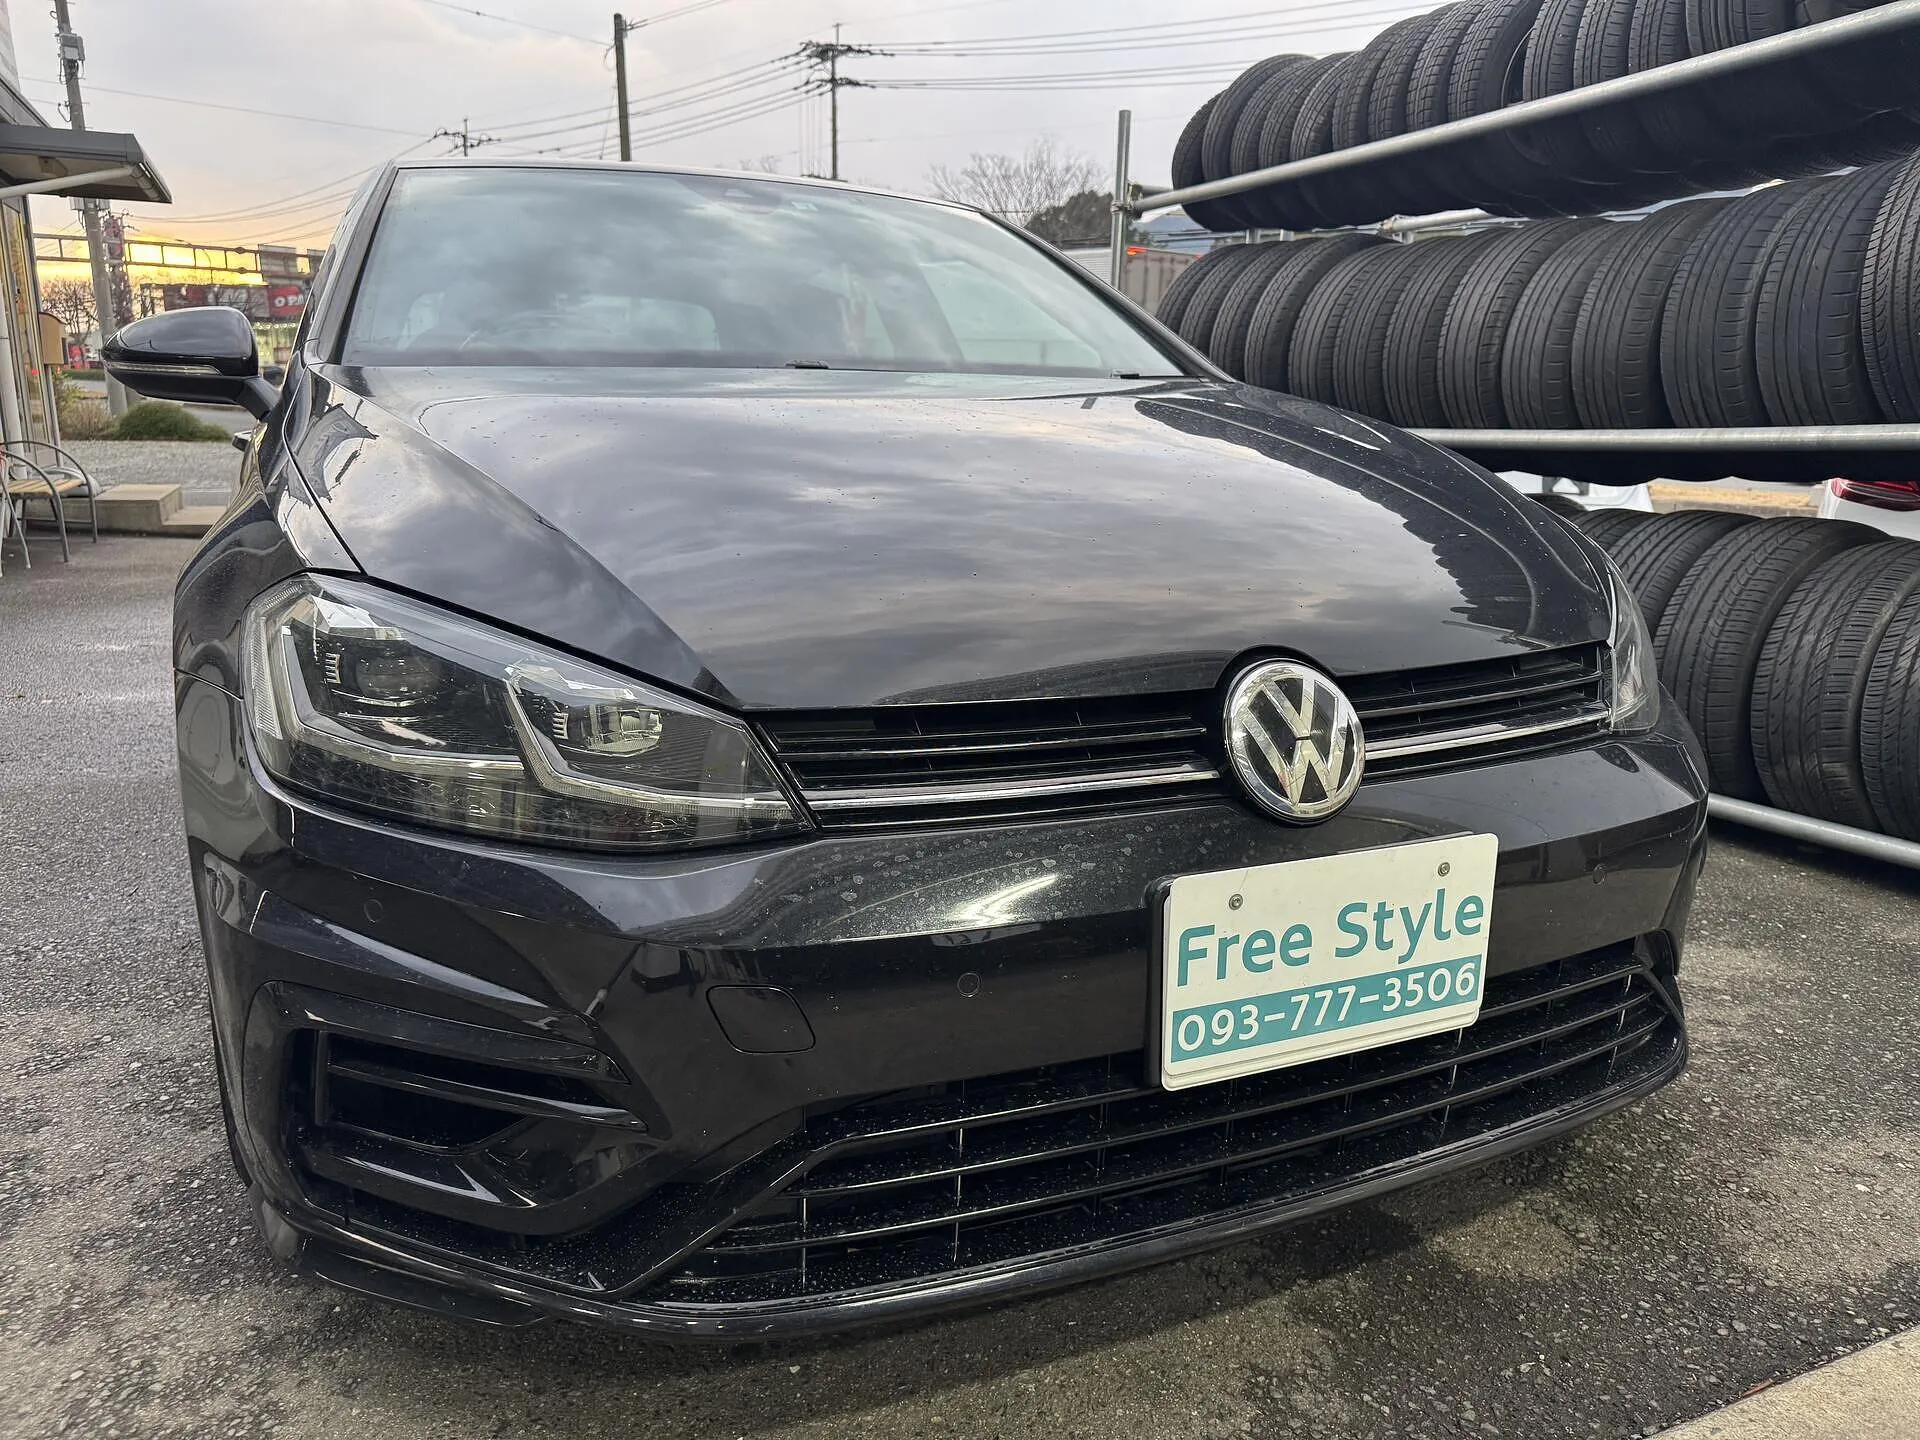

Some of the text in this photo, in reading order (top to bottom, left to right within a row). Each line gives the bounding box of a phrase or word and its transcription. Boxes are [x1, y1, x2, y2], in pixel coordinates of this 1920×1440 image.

[1177, 888, 1485, 988] Free Style
[1177, 962, 1477, 1051] 093-777-3506
